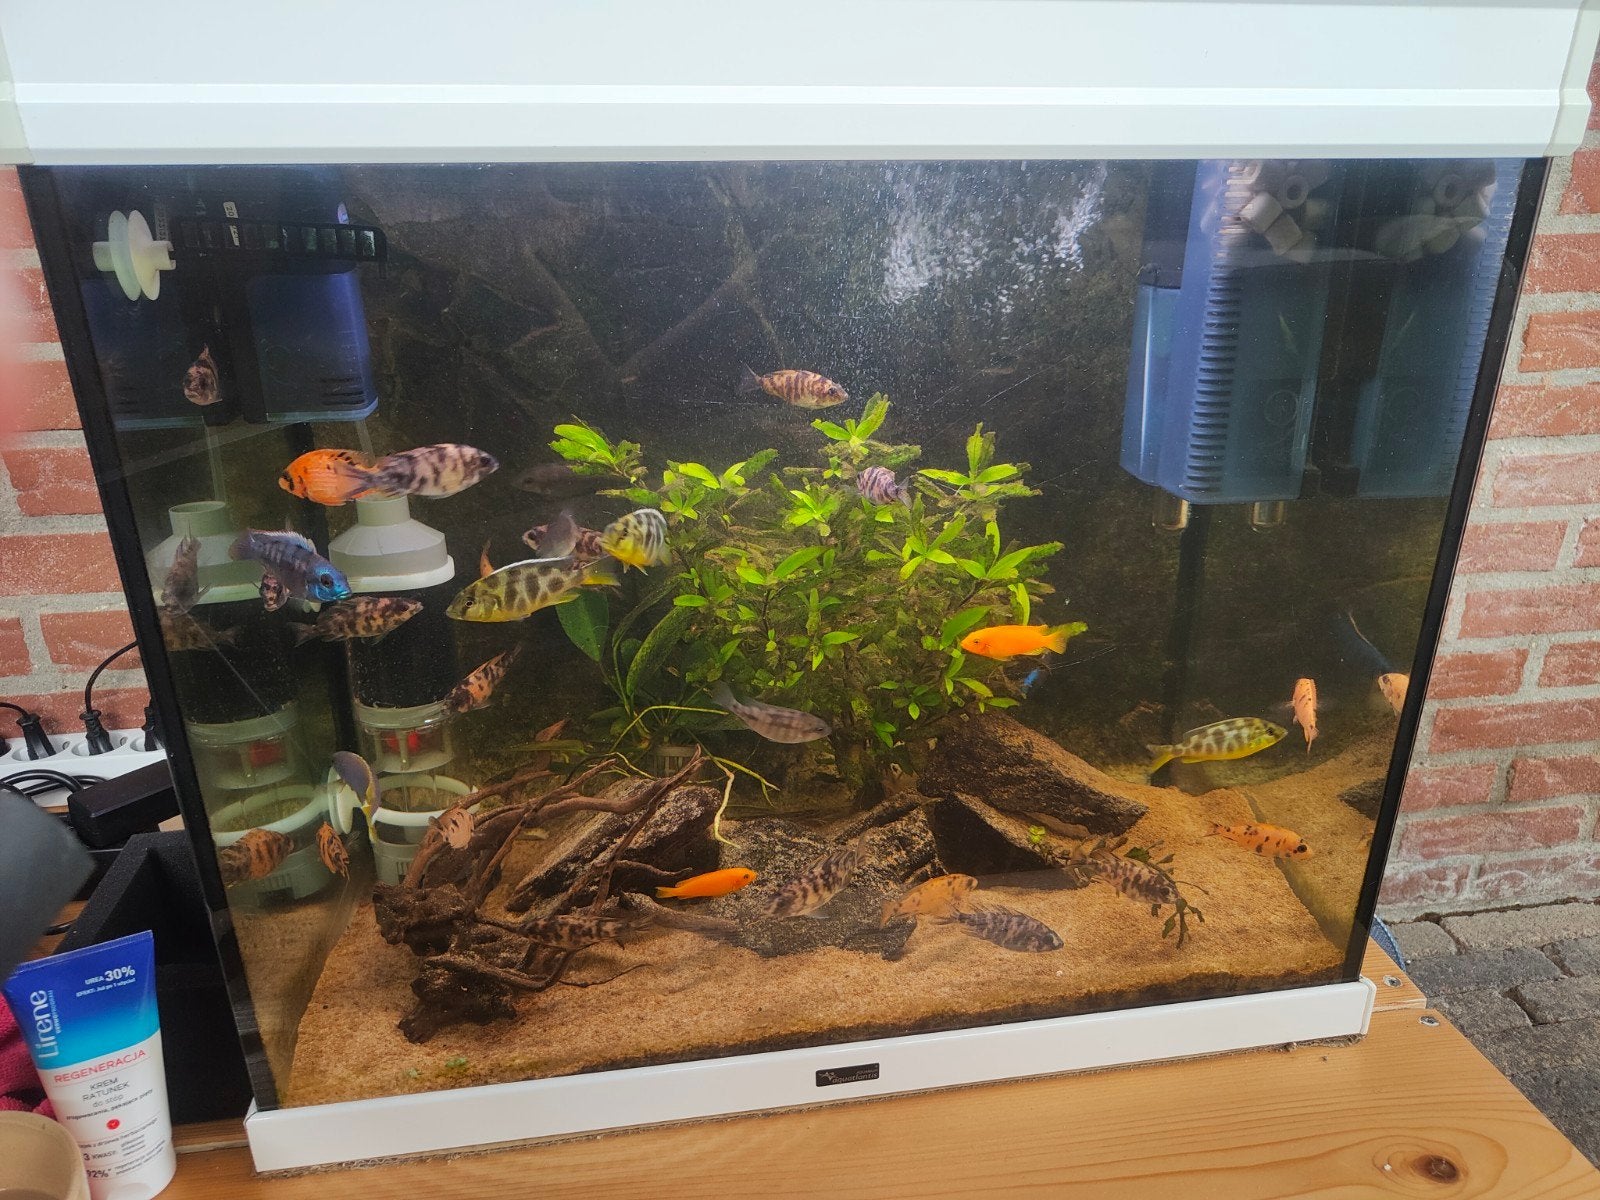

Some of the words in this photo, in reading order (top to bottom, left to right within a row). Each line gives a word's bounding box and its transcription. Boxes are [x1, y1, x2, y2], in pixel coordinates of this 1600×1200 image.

[84, 975, 104, 985] UREA
[104, 965, 136, 982] 30%
[29, 989, 60, 1059] Lirene
[54, 1049, 146, 1083] REGENERACJA
[82, 1081, 130, 1101] RATUNEK
[90, 1077, 119, 1091] KREM
[92, 1100, 103, 1108] do
[83, 1153, 90, 1161] 3
